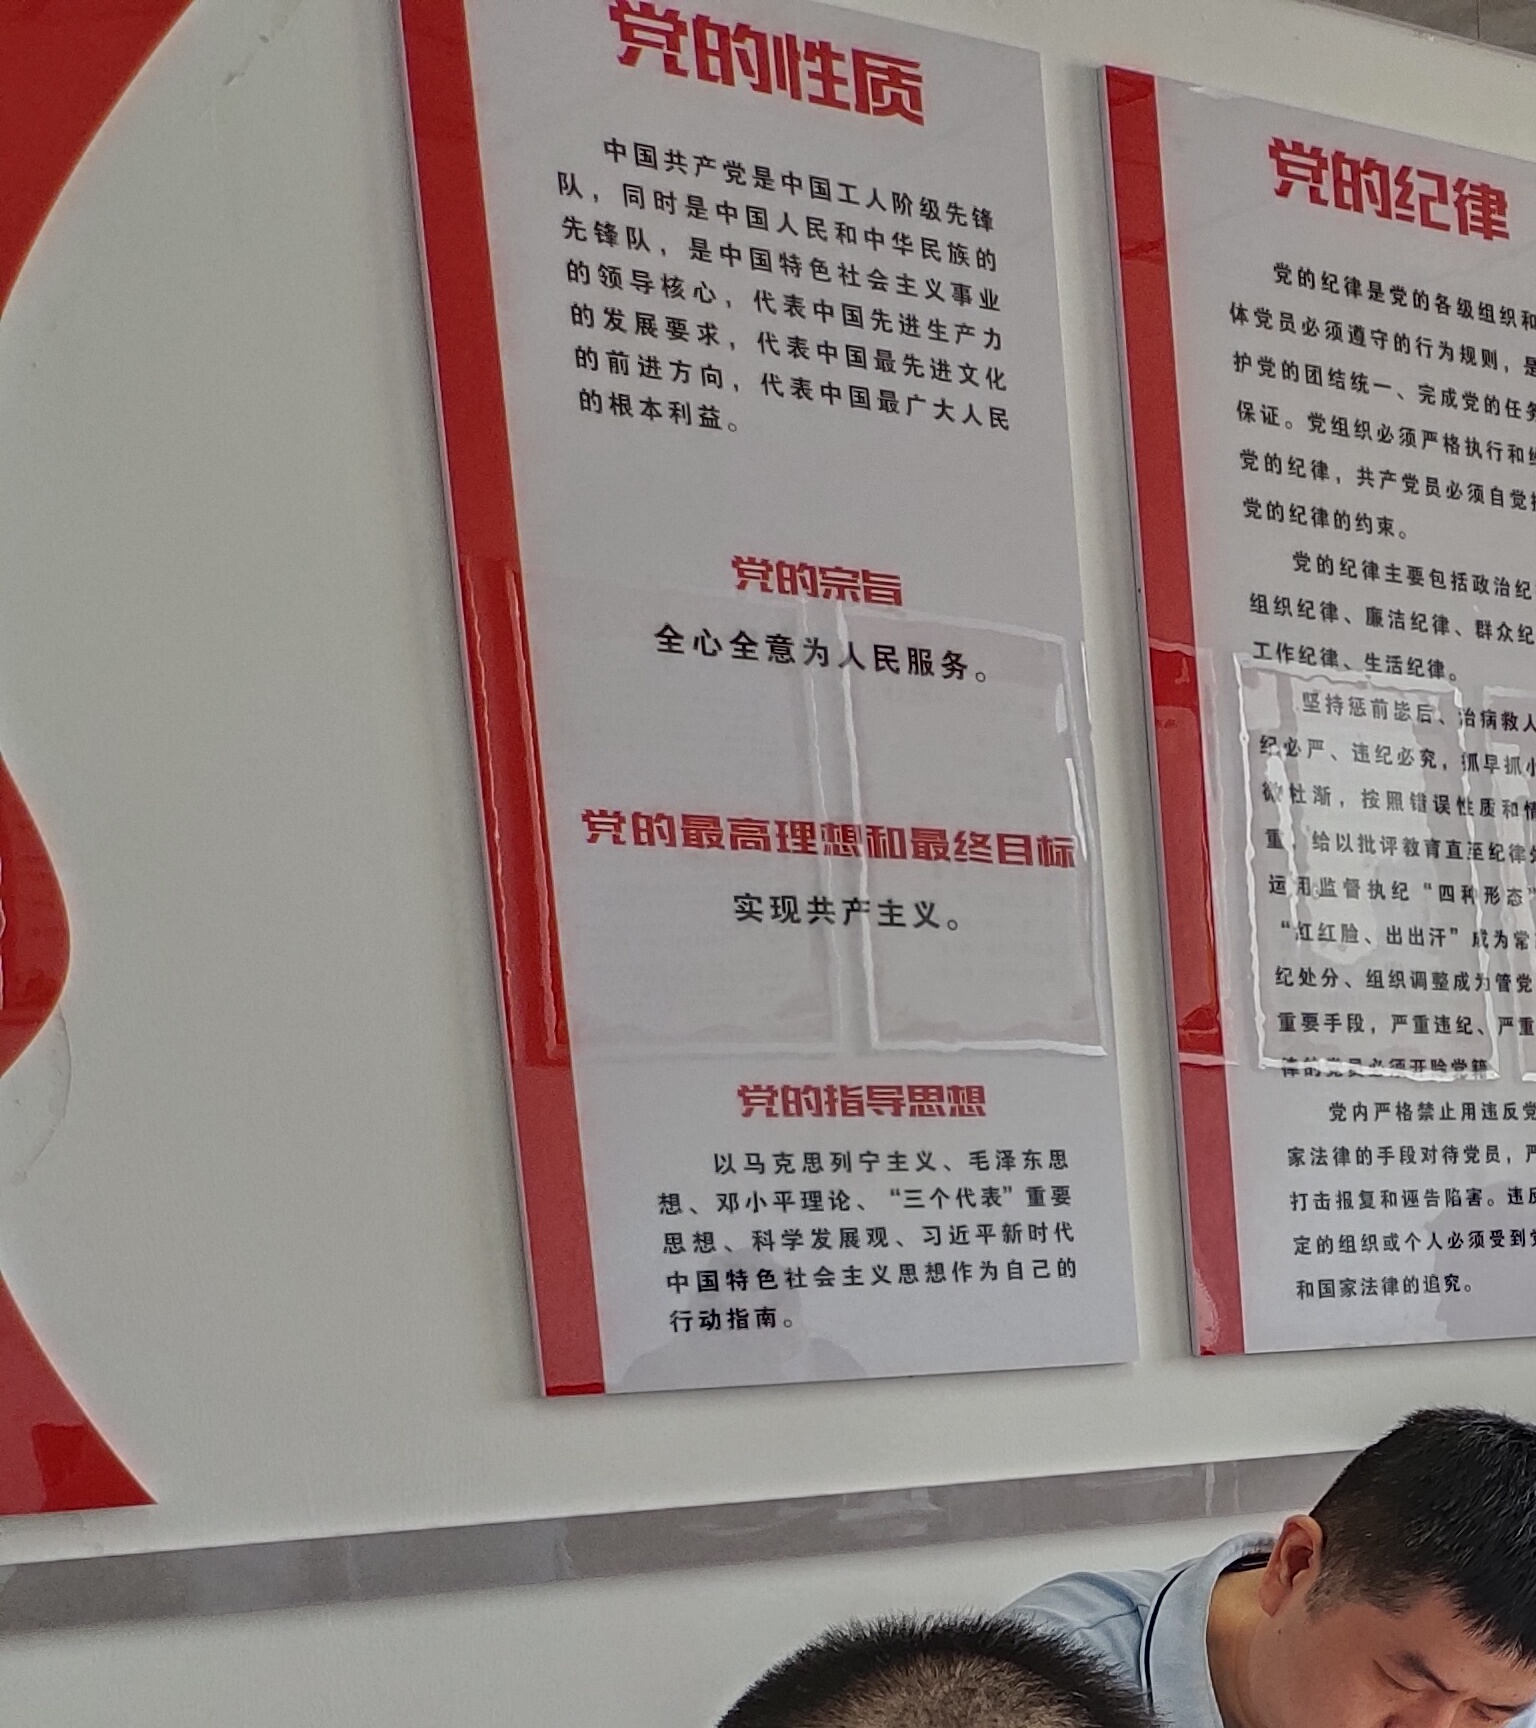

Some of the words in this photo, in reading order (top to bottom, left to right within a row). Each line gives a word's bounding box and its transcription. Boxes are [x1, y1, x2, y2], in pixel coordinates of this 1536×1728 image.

[609, 0, 924, 126] 党的性质
[603, 138, 995, 233] 中国共产党是中国工人阶级先锋
[1268, 136, 1509, 241] 党的纪律
[557, 171, 996, 273] 队，同时是中国人民和中华民族的
[562, 216, 1001, 313] 先锋队，是中国特色社会主义事业
[566, 260, 1002, 352] 的领导核心，代表中国先进生产力
[570, 303, 1007, 393] 的发展要求，代表中国最先进文化
[575, 345, 1010, 432] 的前进方向，代表中国最广大人民
[579, 387, 738, 434] 的根本利益。
[1243, 497, 1408, 540] 党的纪律的约束。
[731, 554, 902, 606] 党的宗旨
[654, 623, 987, 685] 全心全意为人民服务。
[1252, 641, 1459, 682] 工作纪律、生活纪律。
[581, 808, 1077, 869] 党的最高理想和最终目标
[733, 893, 960, 931] 实现共产主义。
[736, 1083, 986, 1119] 党的指导思想
[713, 1147, 1069, 1175] 以马克思列宁主义、毛泽东思
[662, 1220, 1075, 1255] 思想、科学发展观、习近平新时代
[666, 1256, 1077, 1294] 中国特色社会主义思想作为自己的
[1296, 1272, 1473, 1300] 和国家法律的追究。
[669, 1306, 794, 1333] 行动指南。
